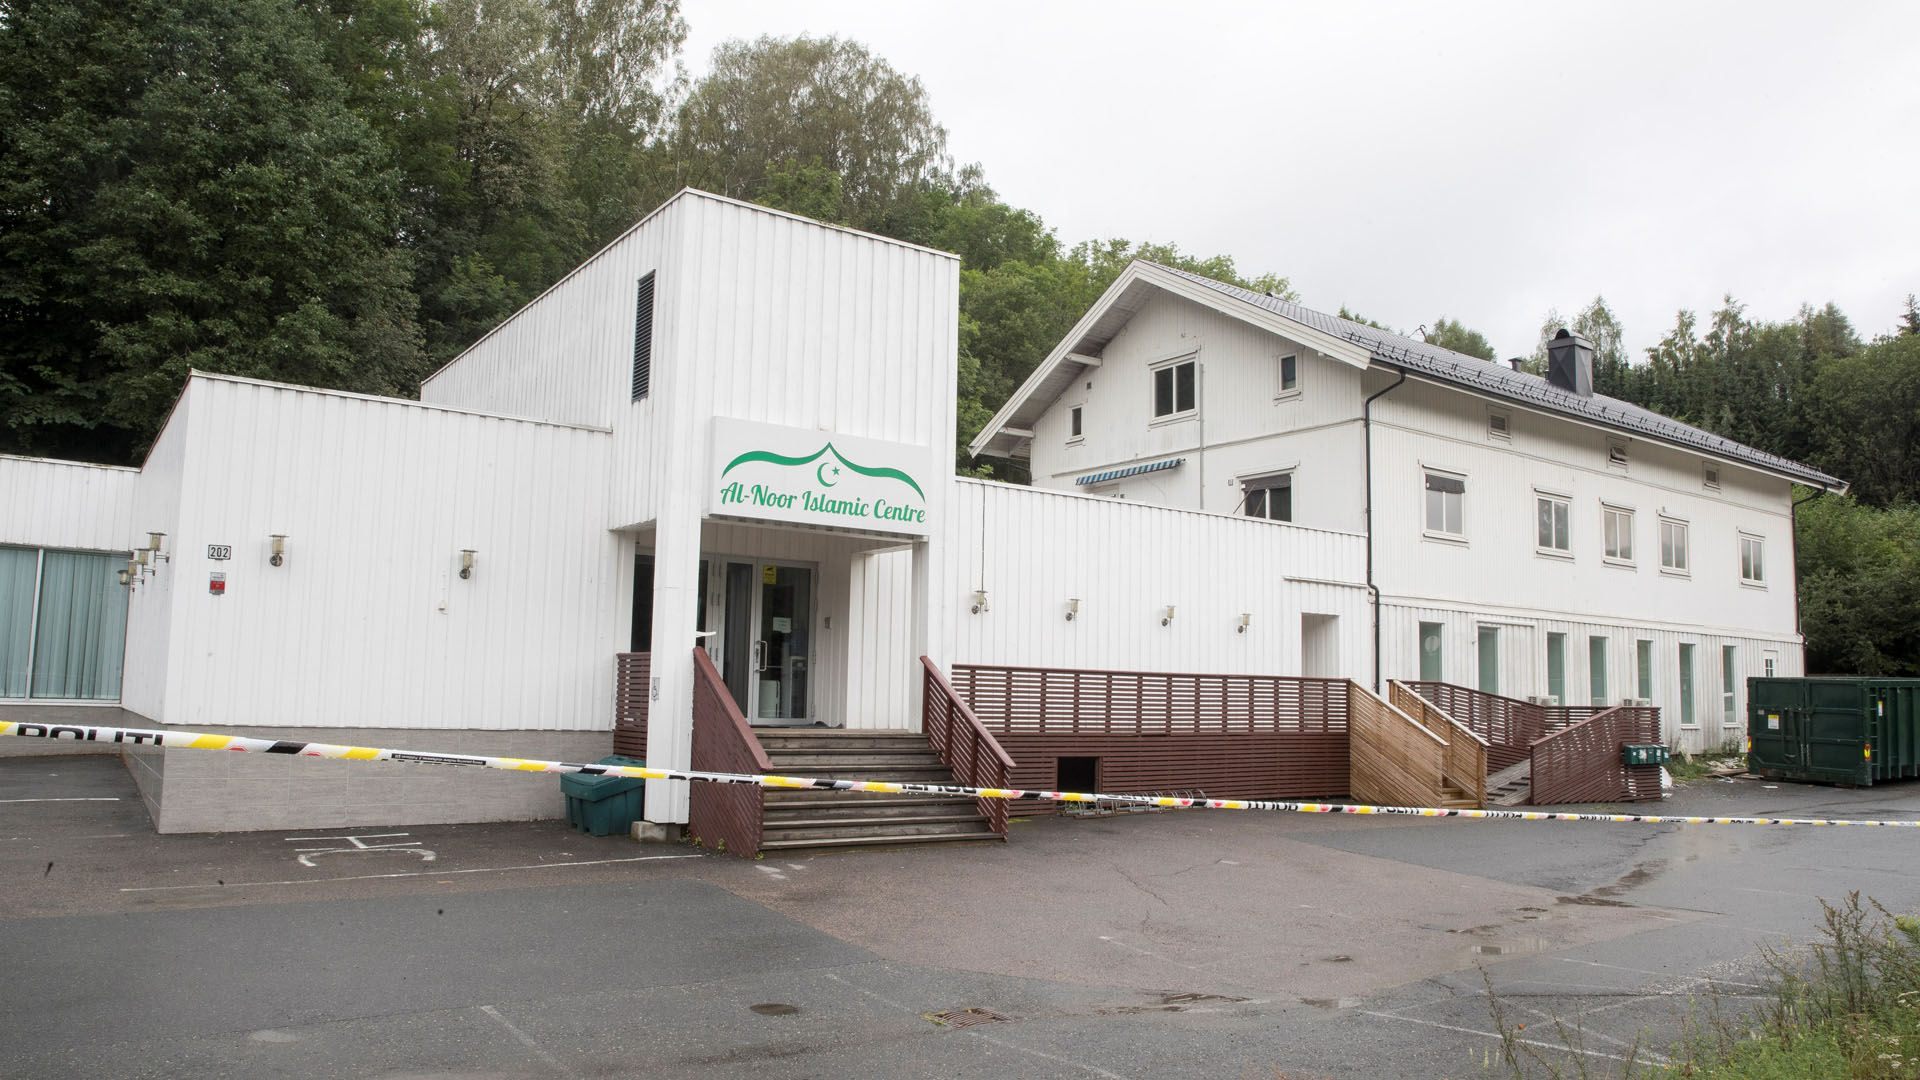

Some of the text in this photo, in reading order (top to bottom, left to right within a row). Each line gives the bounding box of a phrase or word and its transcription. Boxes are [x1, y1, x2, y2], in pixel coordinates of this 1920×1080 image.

[720, 481, 926, 523] Al-Noor Islamic Centre
[209, 546, 229, 558] 202
